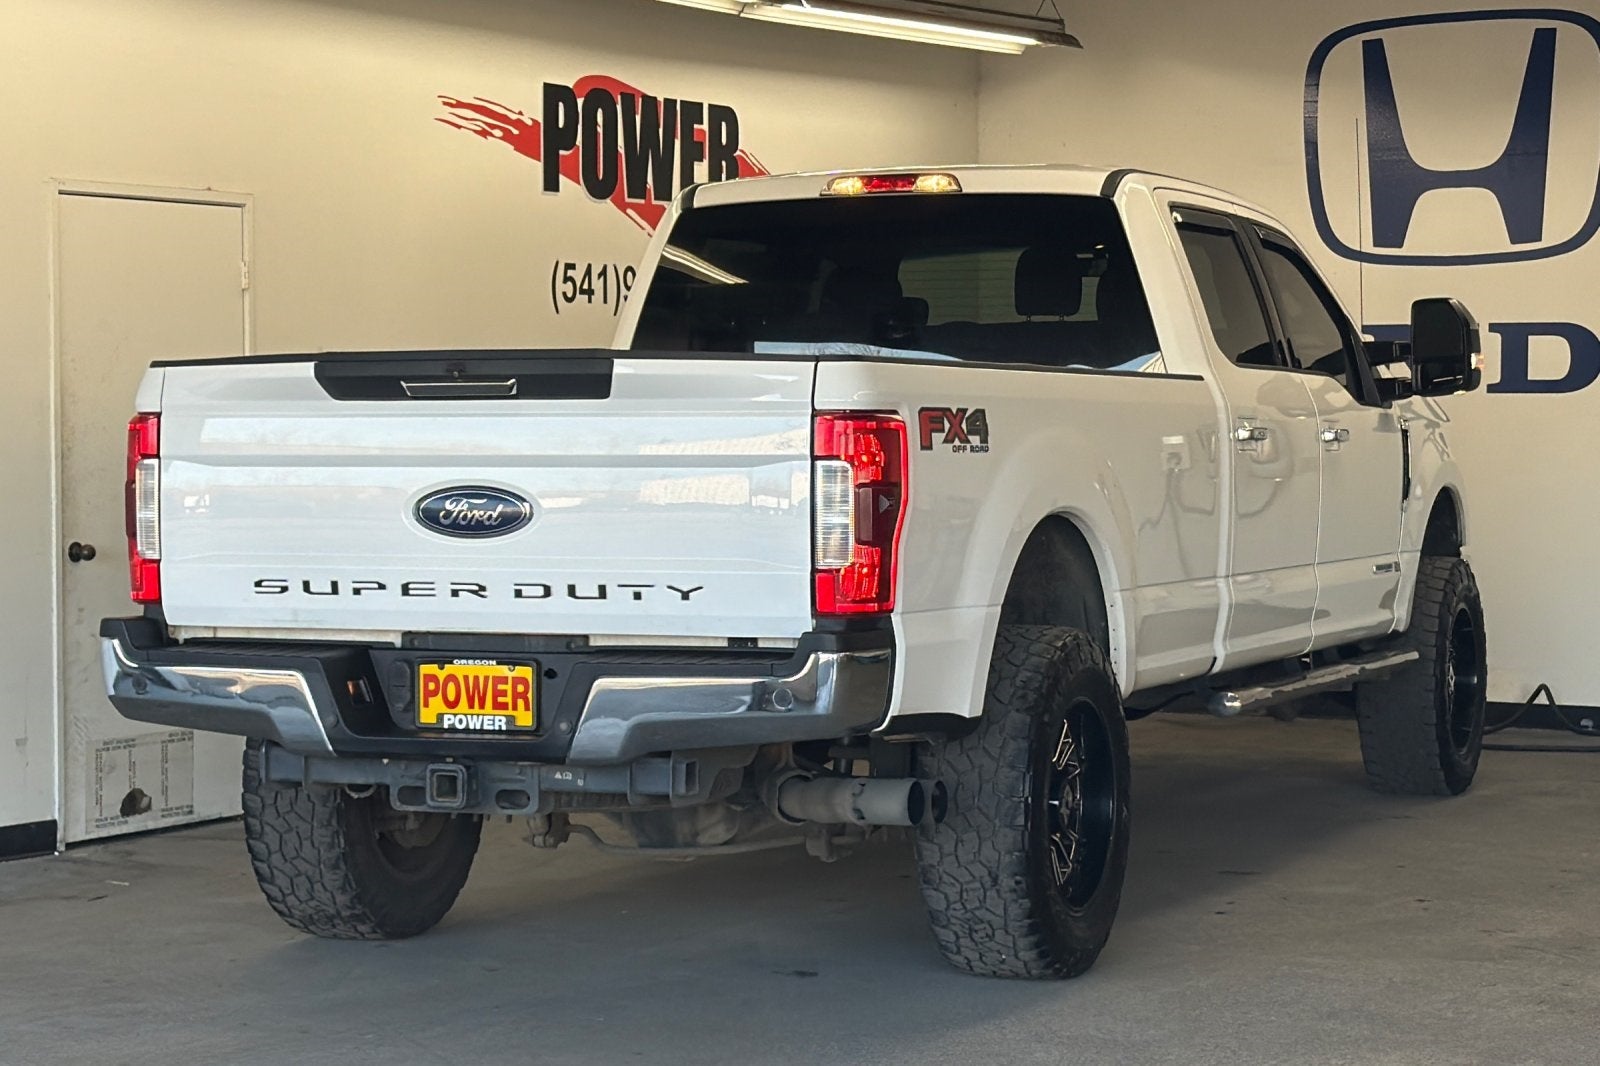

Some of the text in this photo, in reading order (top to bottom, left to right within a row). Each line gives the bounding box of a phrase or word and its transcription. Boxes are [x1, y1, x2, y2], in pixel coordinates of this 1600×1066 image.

[543, 81, 739, 202] POWER
[918, 407, 989, 451] FX4
[952, 445, 989, 453] OFF ROAD
[440, 497, 504, 526] Ford
[254, 579, 704, 601] SUPER DUTY
[453, 658, 497, 666] OREGON
[422, 673, 531, 712] POWER
[443, 714, 507, 731] POWER
